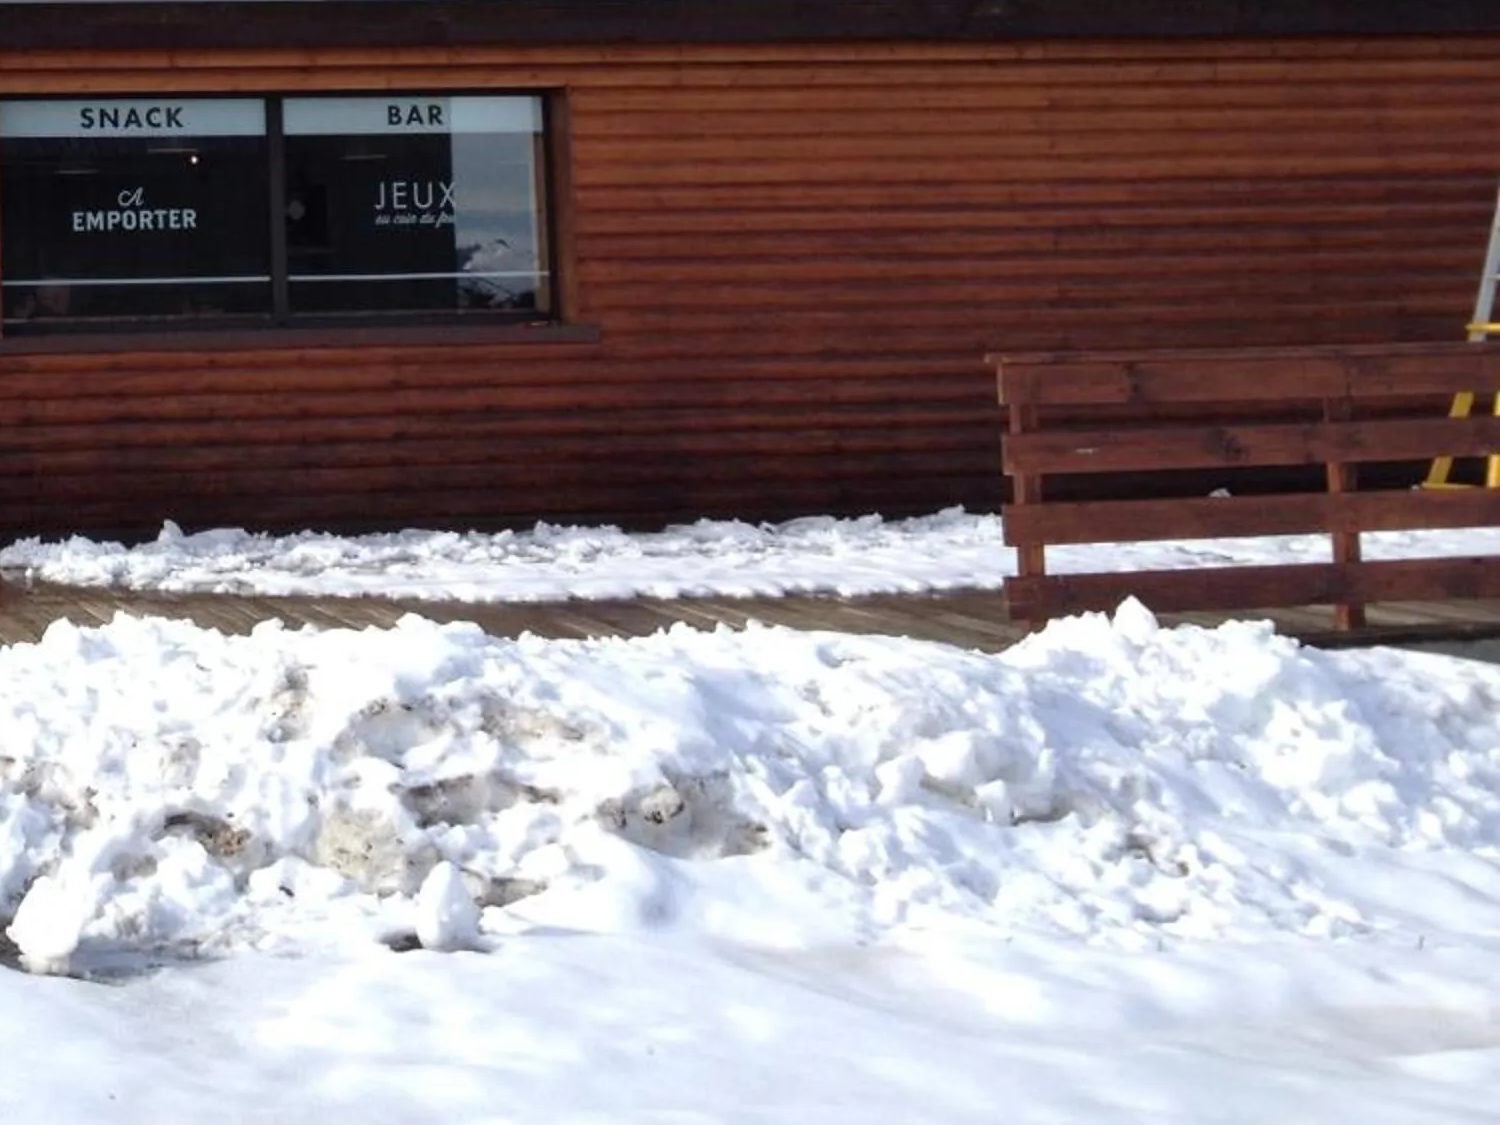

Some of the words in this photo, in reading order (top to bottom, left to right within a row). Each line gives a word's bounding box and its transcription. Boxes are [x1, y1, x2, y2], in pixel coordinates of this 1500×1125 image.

[79, 106, 185, 130] SNACK
[387, 104, 444, 126] BAR
[374, 181, 456, 210] JEUX
[72, 209, 198, 232] EMPORTER
